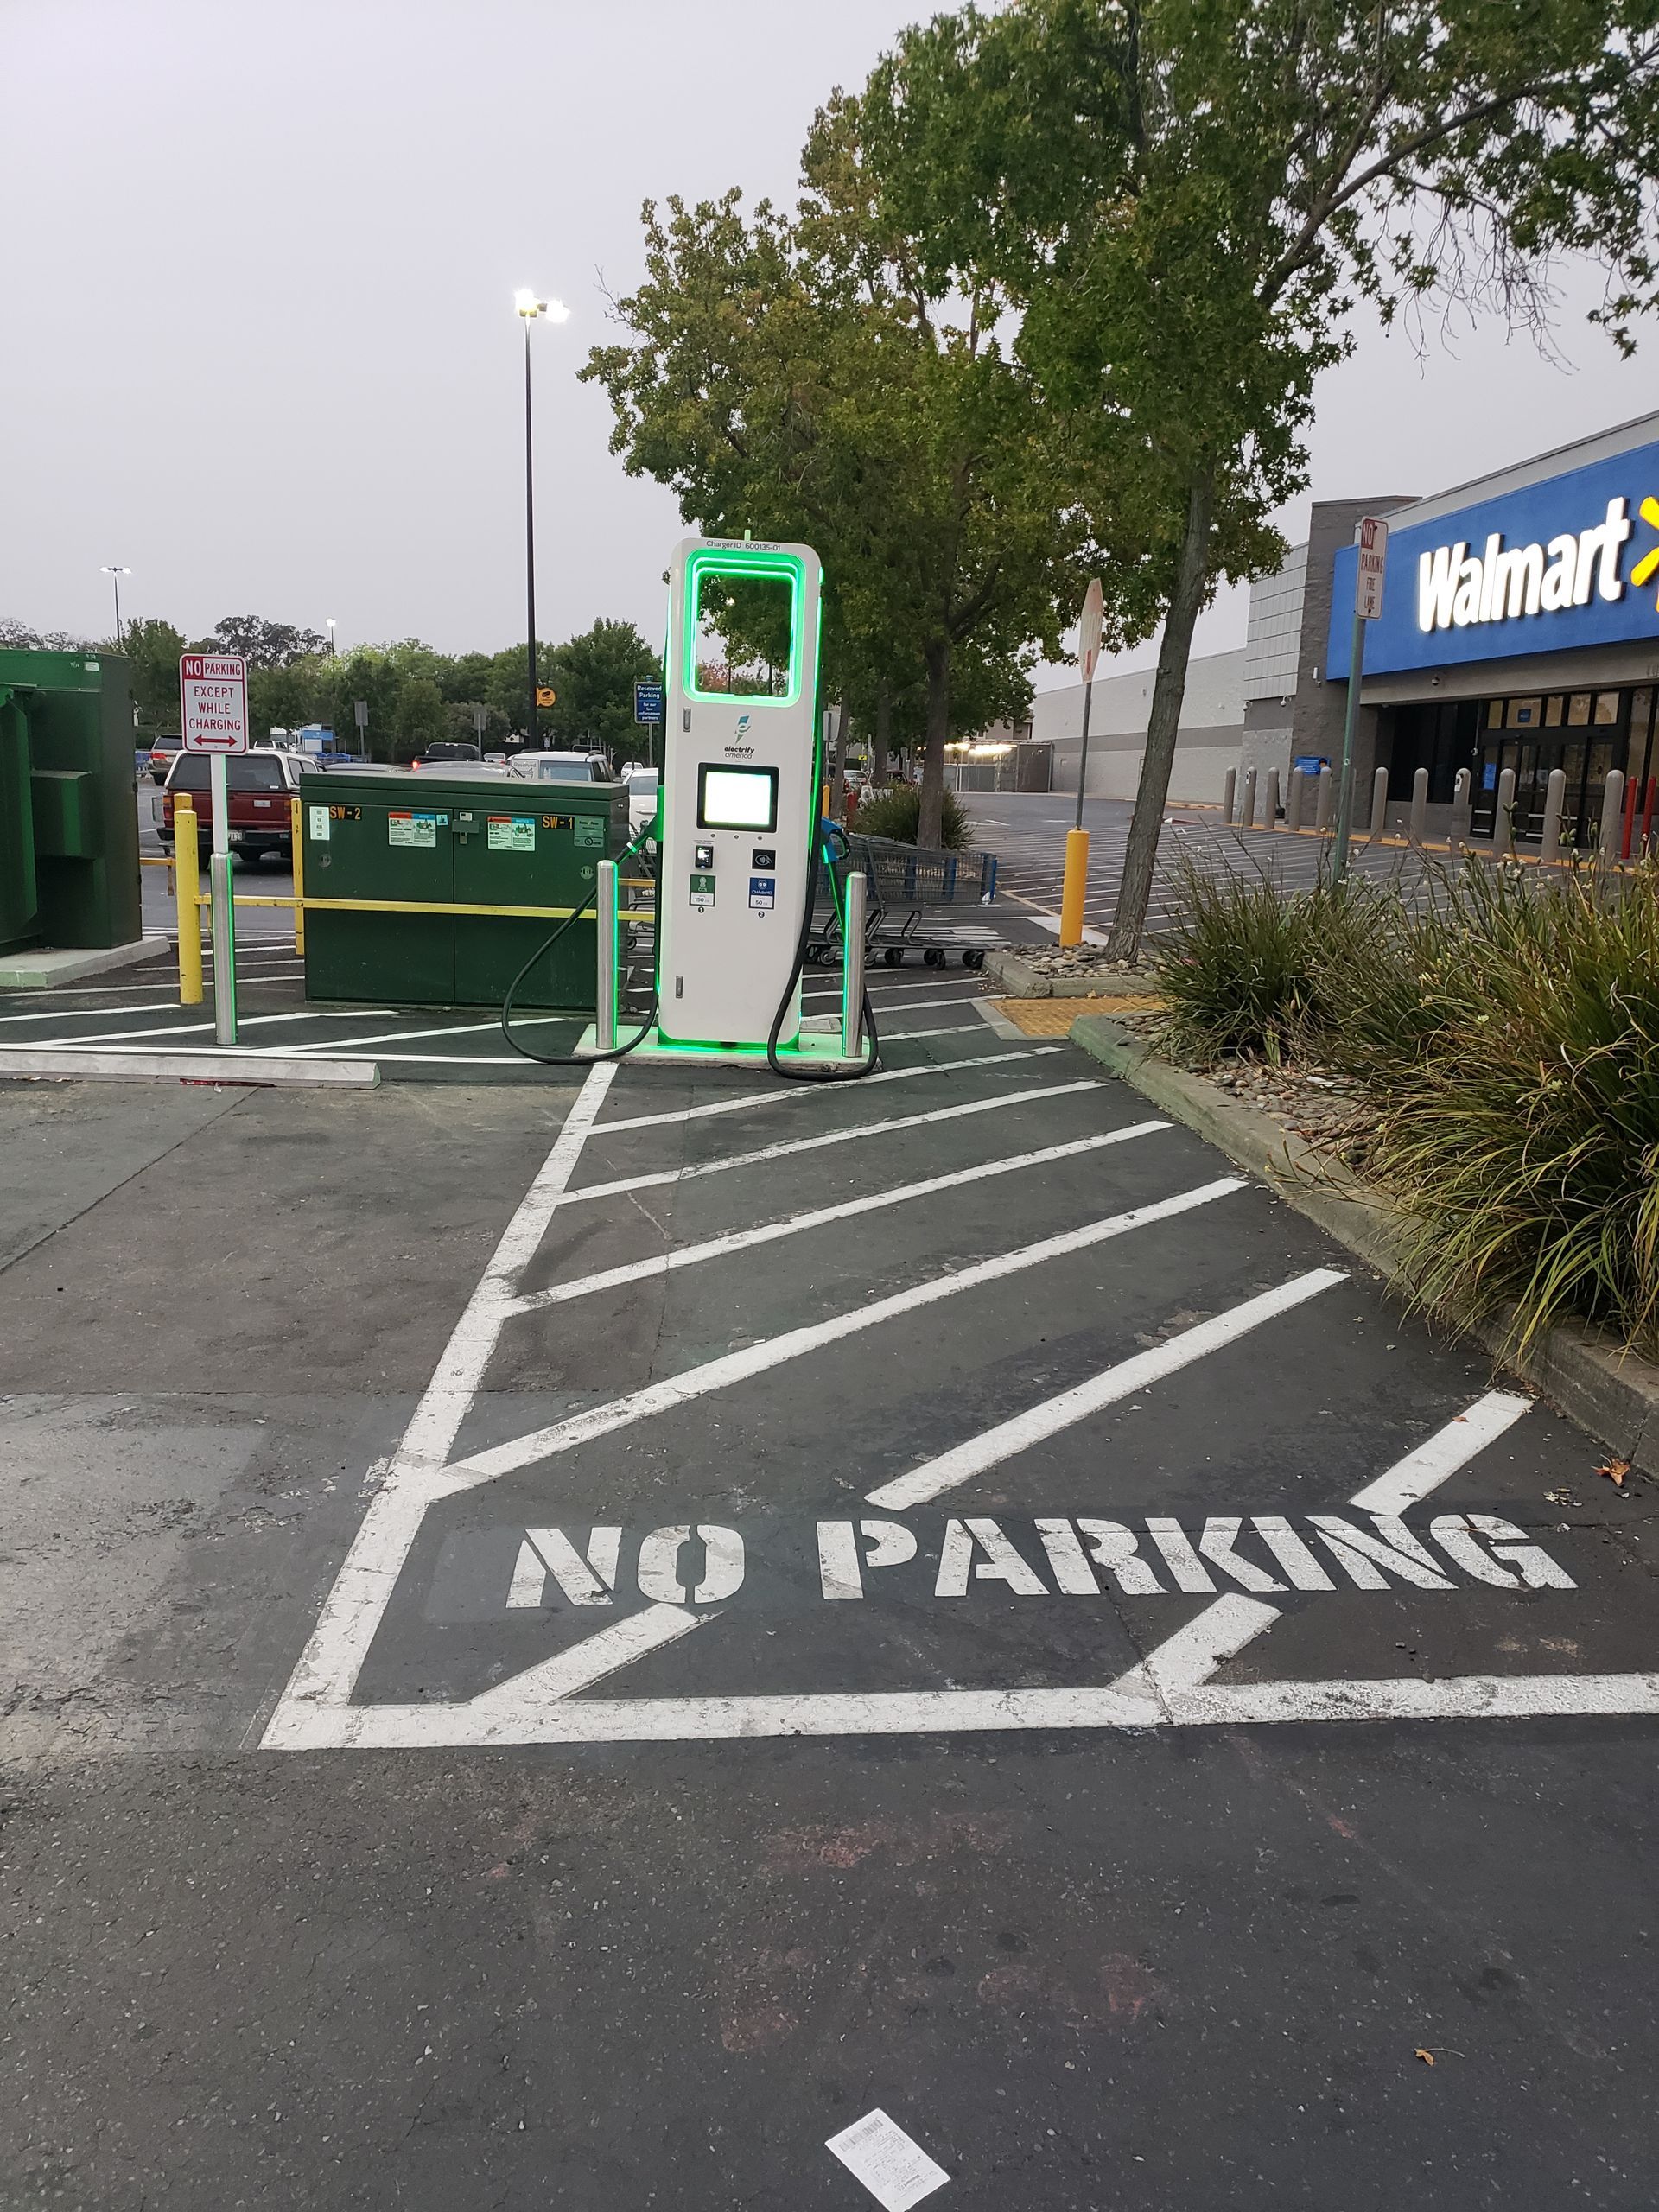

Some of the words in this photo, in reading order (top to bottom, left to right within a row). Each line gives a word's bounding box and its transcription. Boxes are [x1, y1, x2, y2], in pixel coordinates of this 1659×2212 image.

[1363, 523, 1374, 546] NO
[706, 540, 734, 549] Charger
[745, 543, 781, 551] 600135-01
[1361, 553, 1384, 574] PARKING
[1419, 496, 1631, 632] Walmart
[185, 660, 201, 676] NO
[204, 662, 241, 676] PARKING
[194, 686, 234, 698] EXCEPT
[198, 702, 231, 715] WHILE
[188, 718, 241, 731] CHARGING
[724, 746, 755, 754] electrify
[329, 805, 361, 820] SW-2
[542, 815, 573, 830] SW-1
[505, 1525, 747, 1607] NO
[816, 1514, 1578, 1600] PARKING
